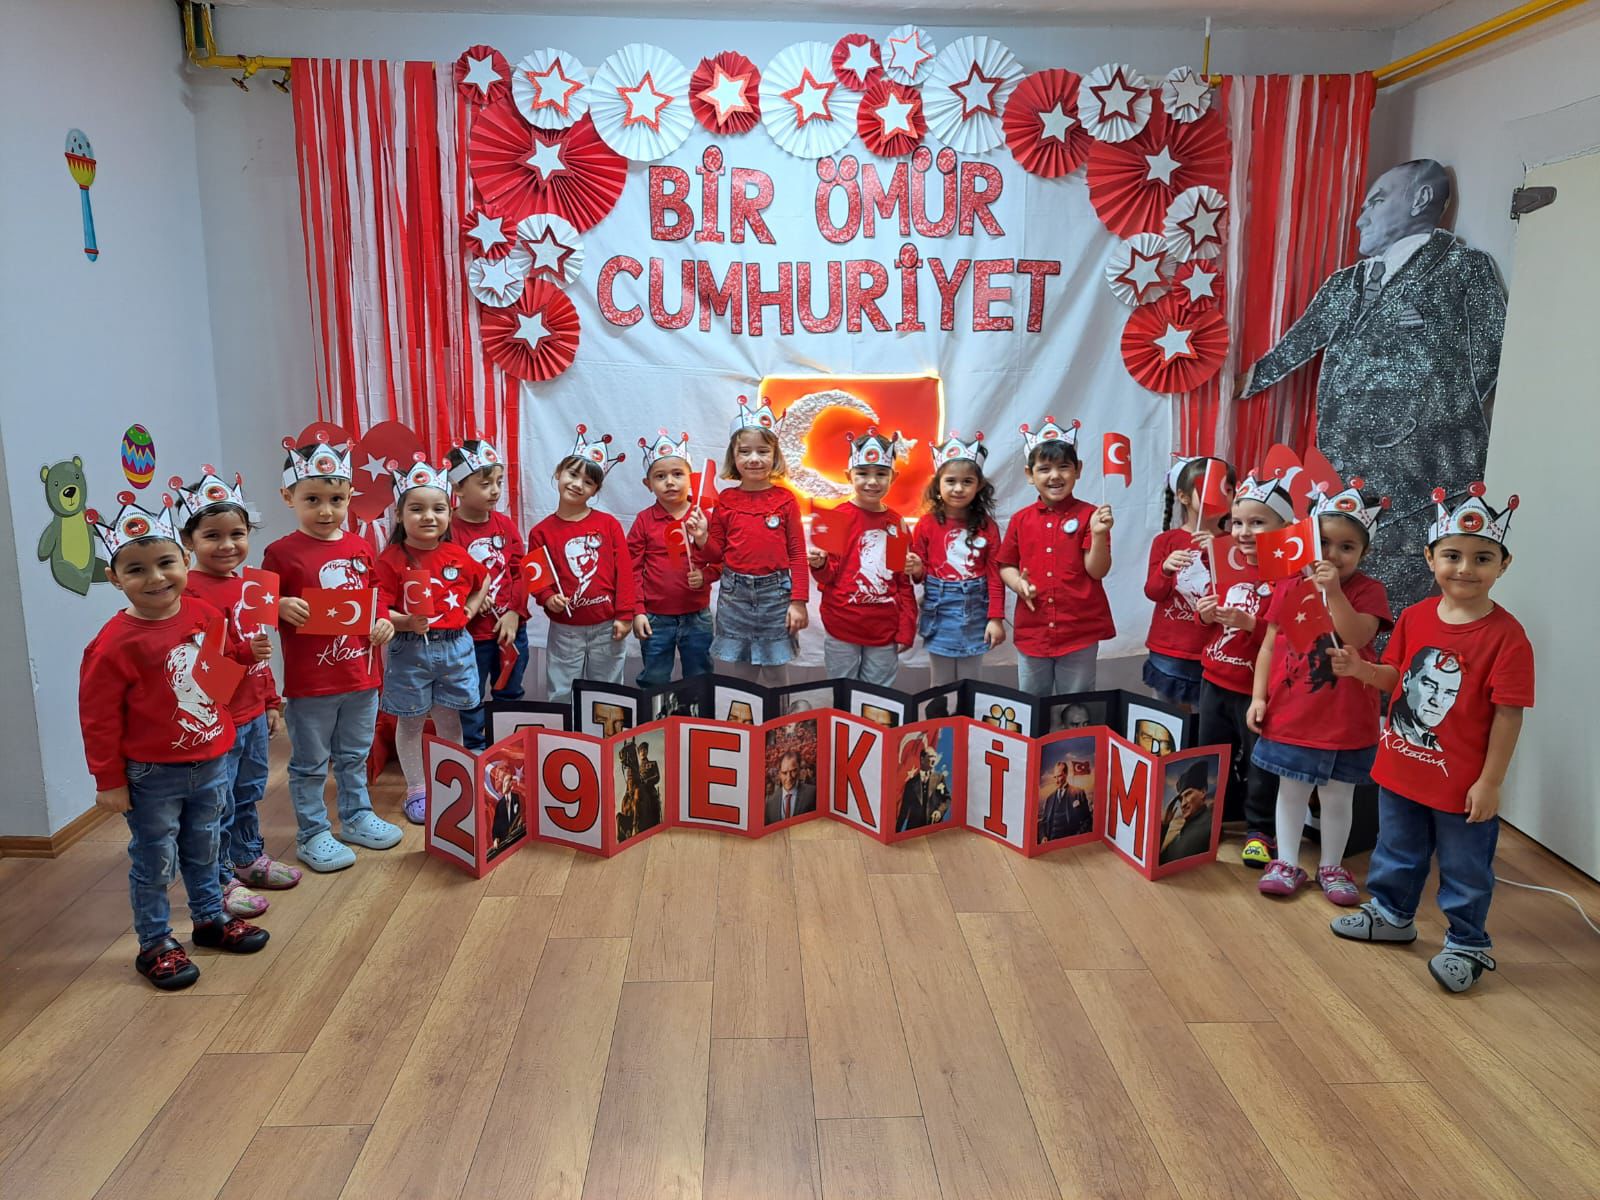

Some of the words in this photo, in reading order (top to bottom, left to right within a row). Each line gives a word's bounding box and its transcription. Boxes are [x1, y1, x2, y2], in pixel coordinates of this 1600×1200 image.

[648, 144, 776, 244] BİR
[815, 145, 1005, 244] ÖMÜR
[597, 242, 1061, 336] CUMHURİYET
[434, 747, 600, 857] 29
[688, 721, 1148, 861] EKİM
